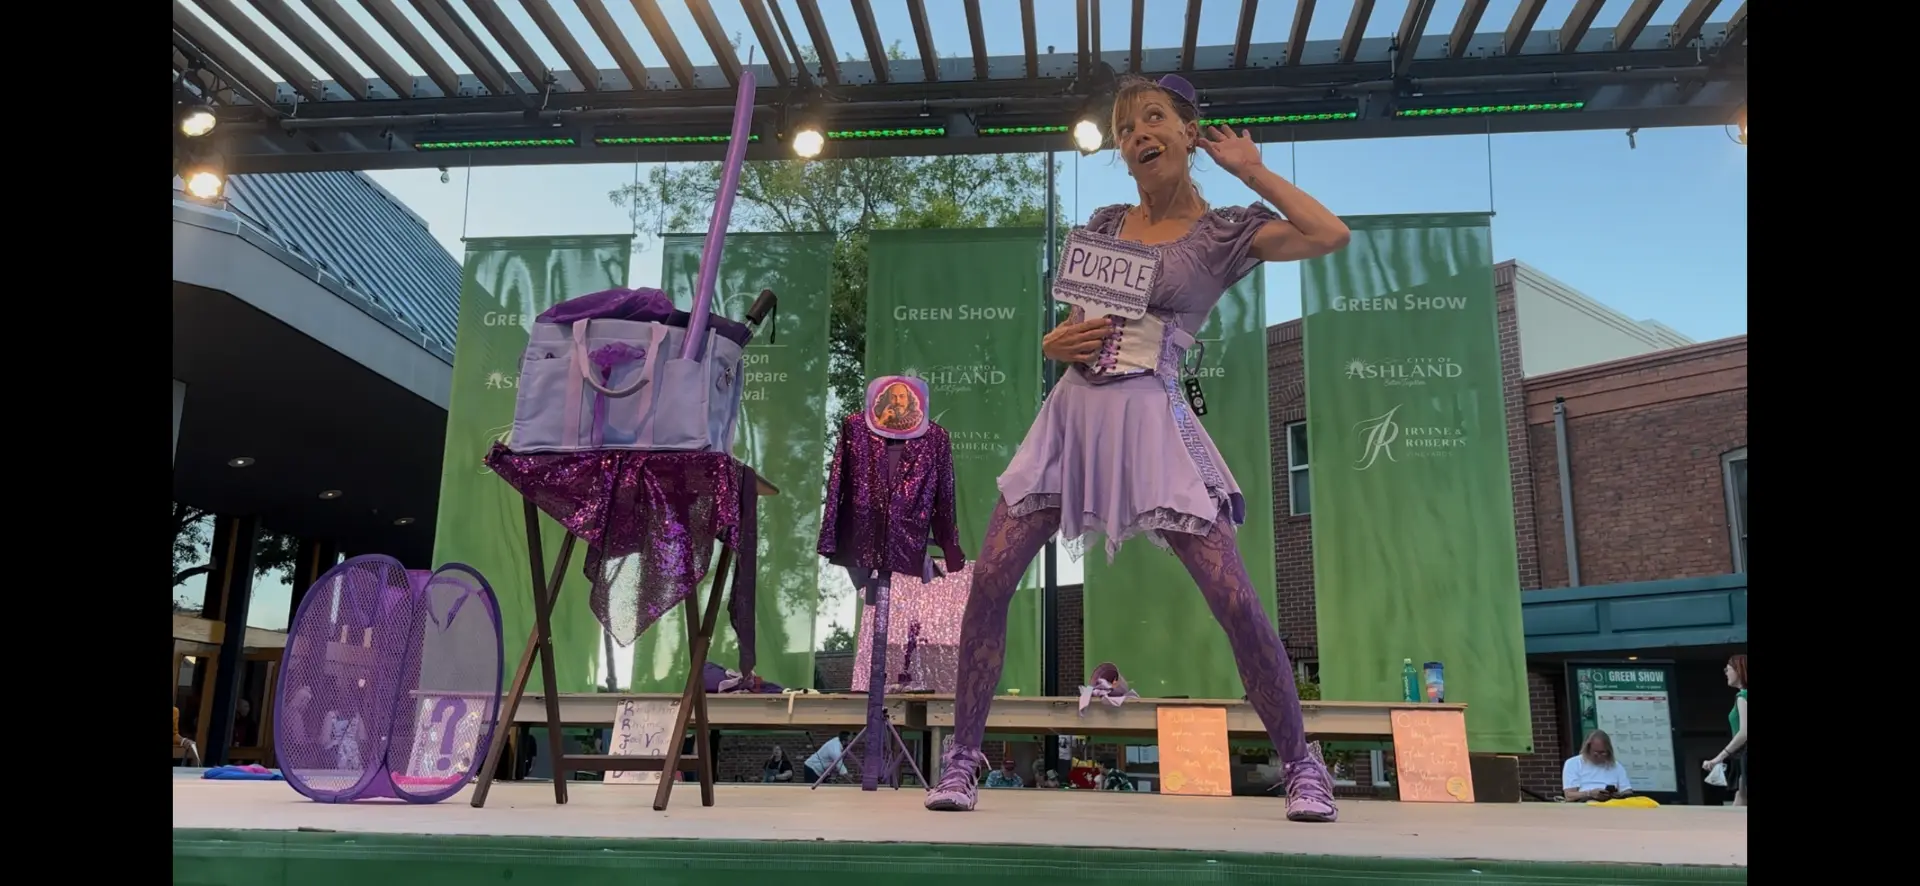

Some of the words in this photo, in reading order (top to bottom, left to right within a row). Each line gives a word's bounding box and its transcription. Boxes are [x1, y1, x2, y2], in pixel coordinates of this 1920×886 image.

[1068, 248, 1153, 292] PURPLE
[1332, 296, 1398, 311] GREEN
[1404, 294, 1468, 310] SHOW
[483, 311, 528, 326] GREE
[893, 305, 953, 320] GREEN
[958, 304, 1016, 320] SHOW
[741, 354, 770, 368] gon
[1346, 360, 1463, 379] ASHLAND
[1405, 427, 1452, 436] IRVINE
[1454, 428, 1462, 436] &
[1405, 438, 1467, 447] ROBERTS
[1608, 671, 1637, 682] GREEN
[1638, 671, 1664, 682] SHOW
